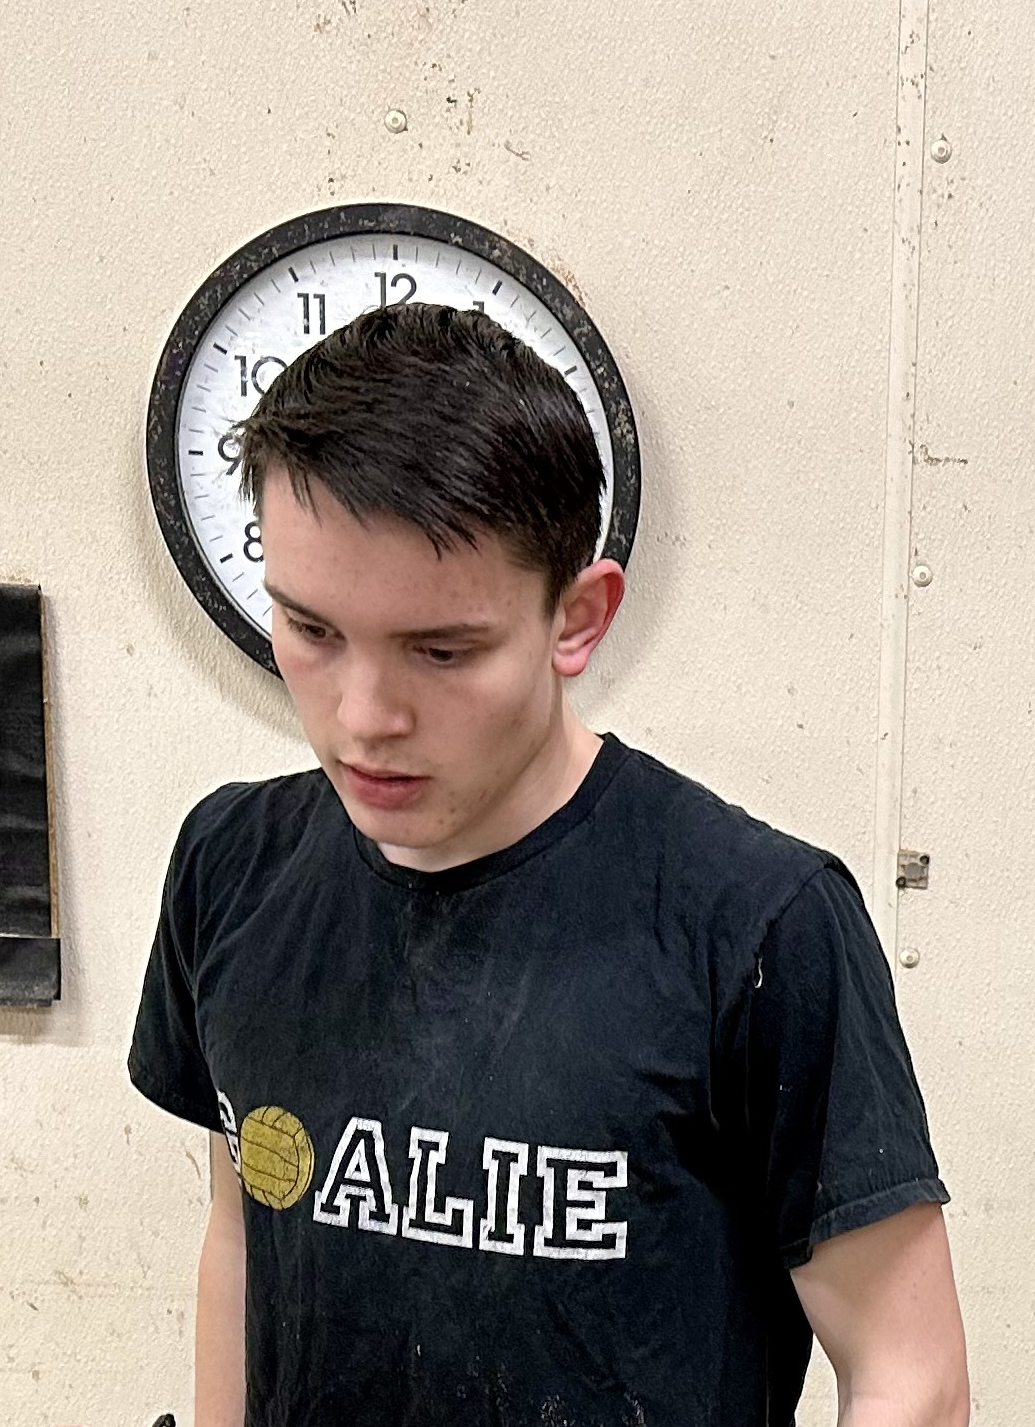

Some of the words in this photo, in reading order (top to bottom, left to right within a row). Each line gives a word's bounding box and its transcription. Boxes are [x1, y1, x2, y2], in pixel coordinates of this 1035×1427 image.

[374, 272, 417, 308] 12
[297, 292, 326, 335] 11
[234, 355, 287, 397] 10
